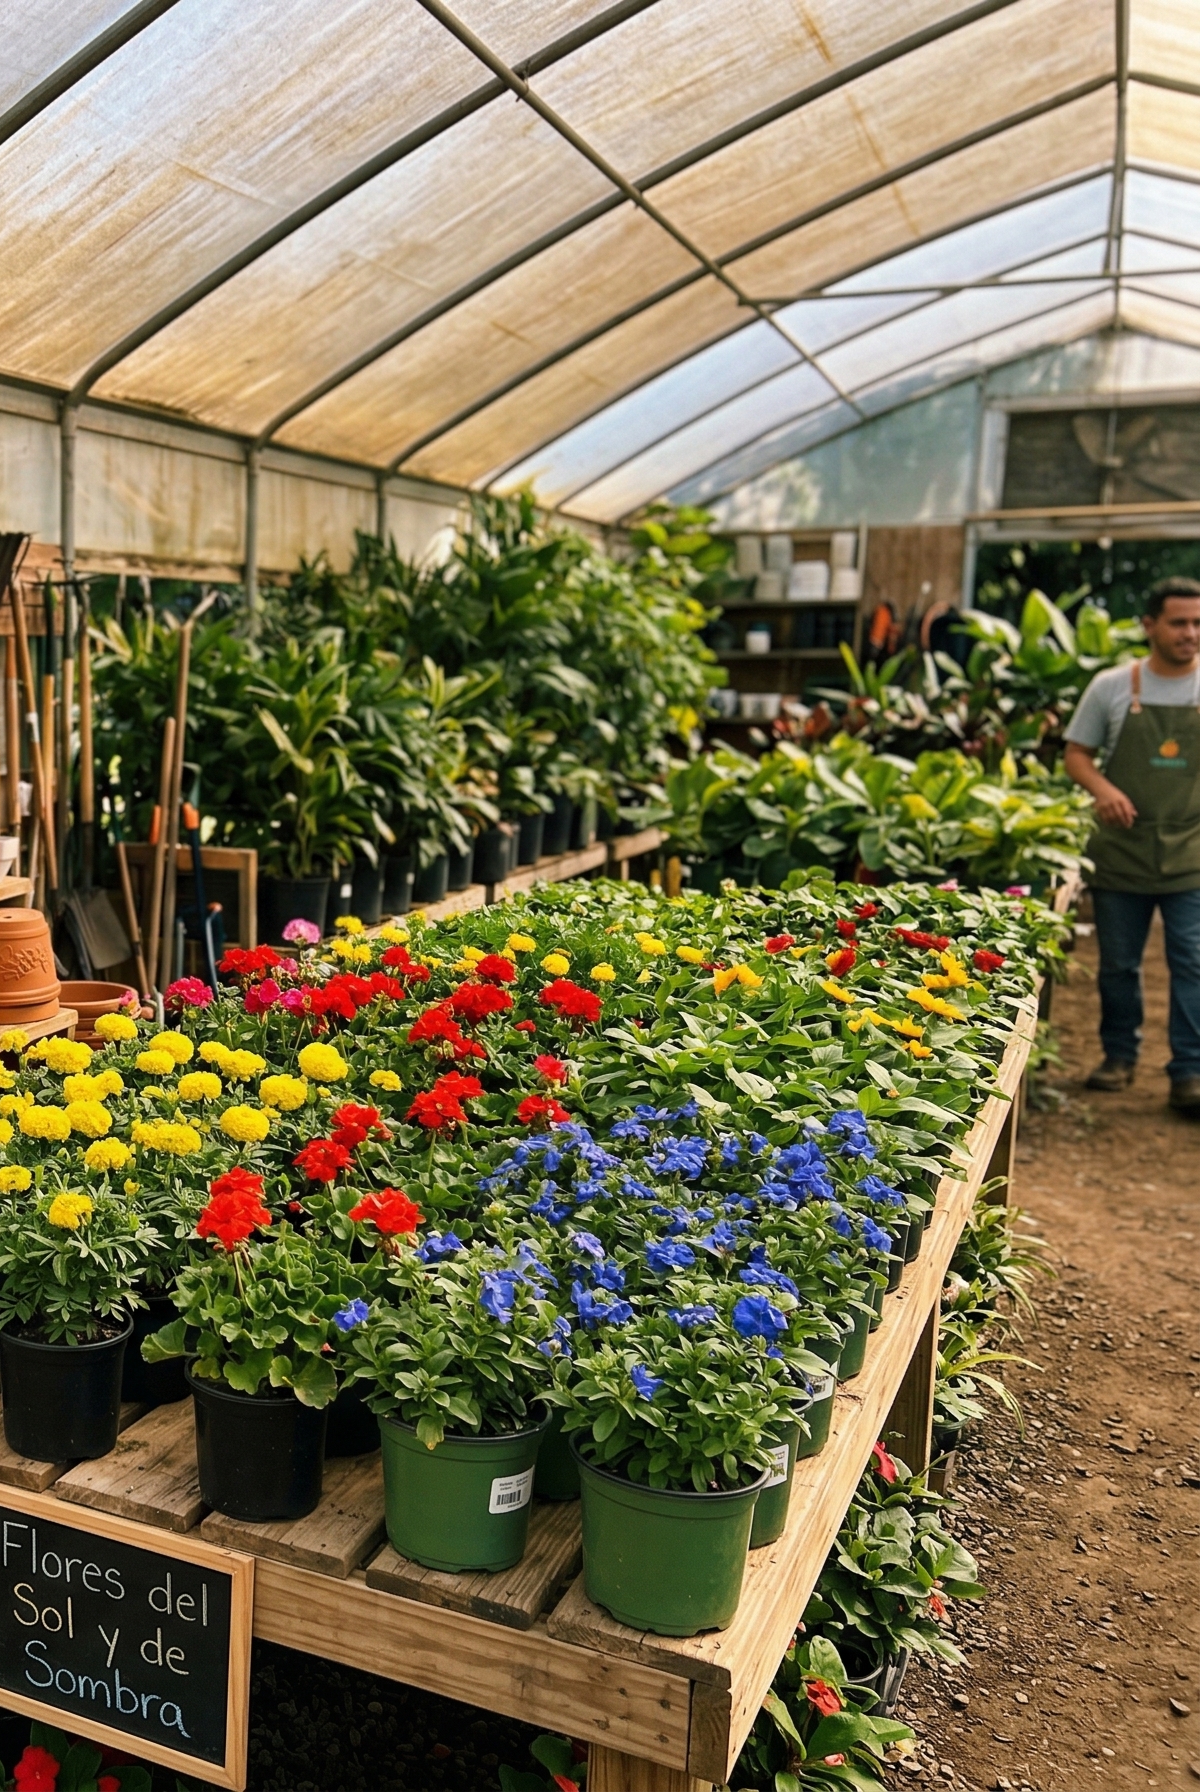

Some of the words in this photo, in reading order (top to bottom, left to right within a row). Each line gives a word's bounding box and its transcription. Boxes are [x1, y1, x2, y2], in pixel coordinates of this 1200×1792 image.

[3, 1521, 125, 1599] Flores
[148, 1572, 208, 1626] del
[13, 1582, 73, 1638] Sol
[98, 1624, 119, 1667] y
[140, 1627, 189, 1675] de
[25, 1640, 191, 1738] Sombra
